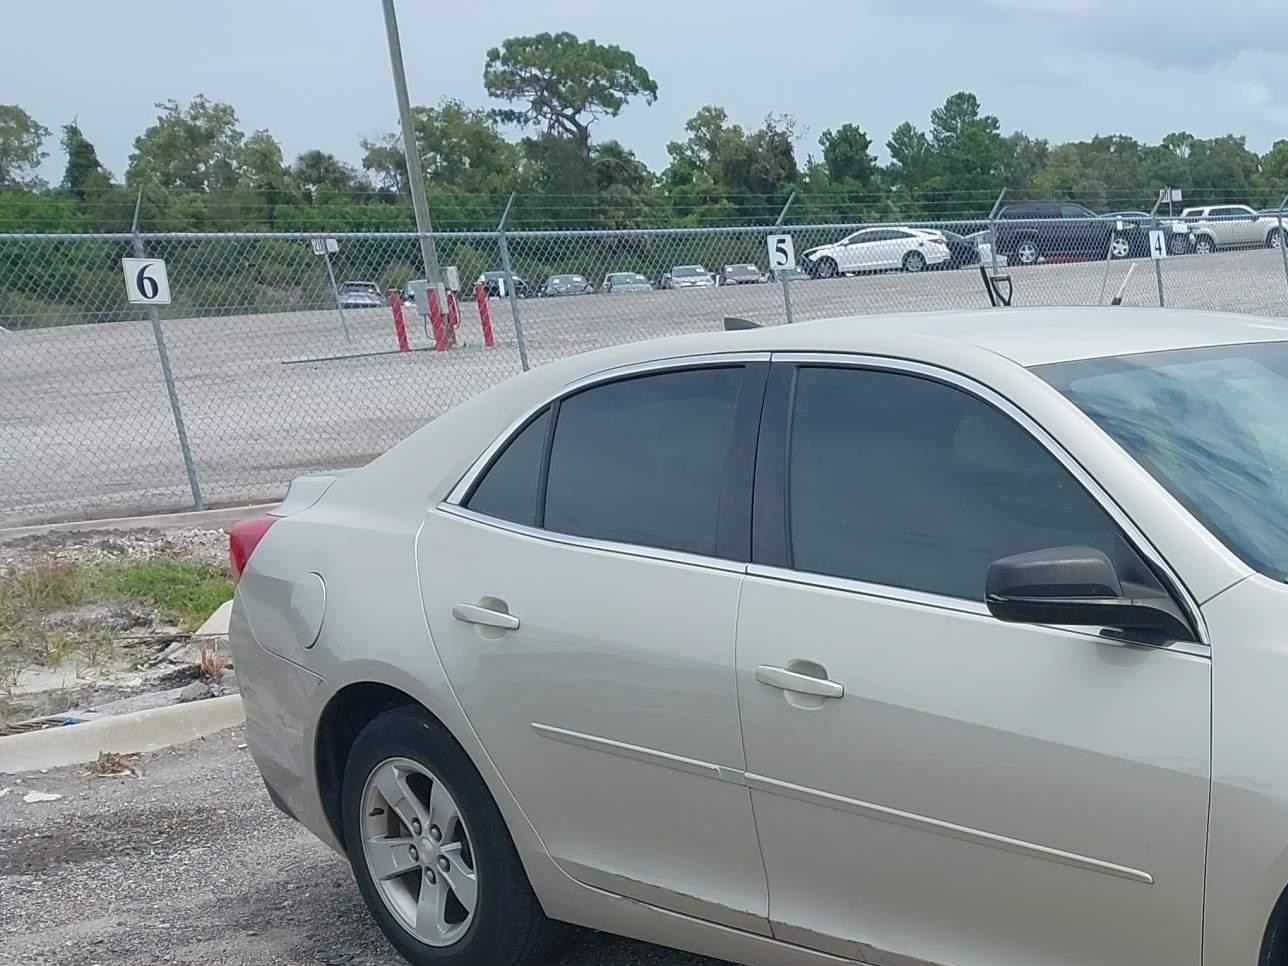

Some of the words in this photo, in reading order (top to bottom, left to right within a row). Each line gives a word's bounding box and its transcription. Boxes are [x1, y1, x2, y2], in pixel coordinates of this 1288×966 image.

[775, 238, 789, 266] 5
[1154, 233, 1162, 256] 4
[136, 262, 159, 300] 6
